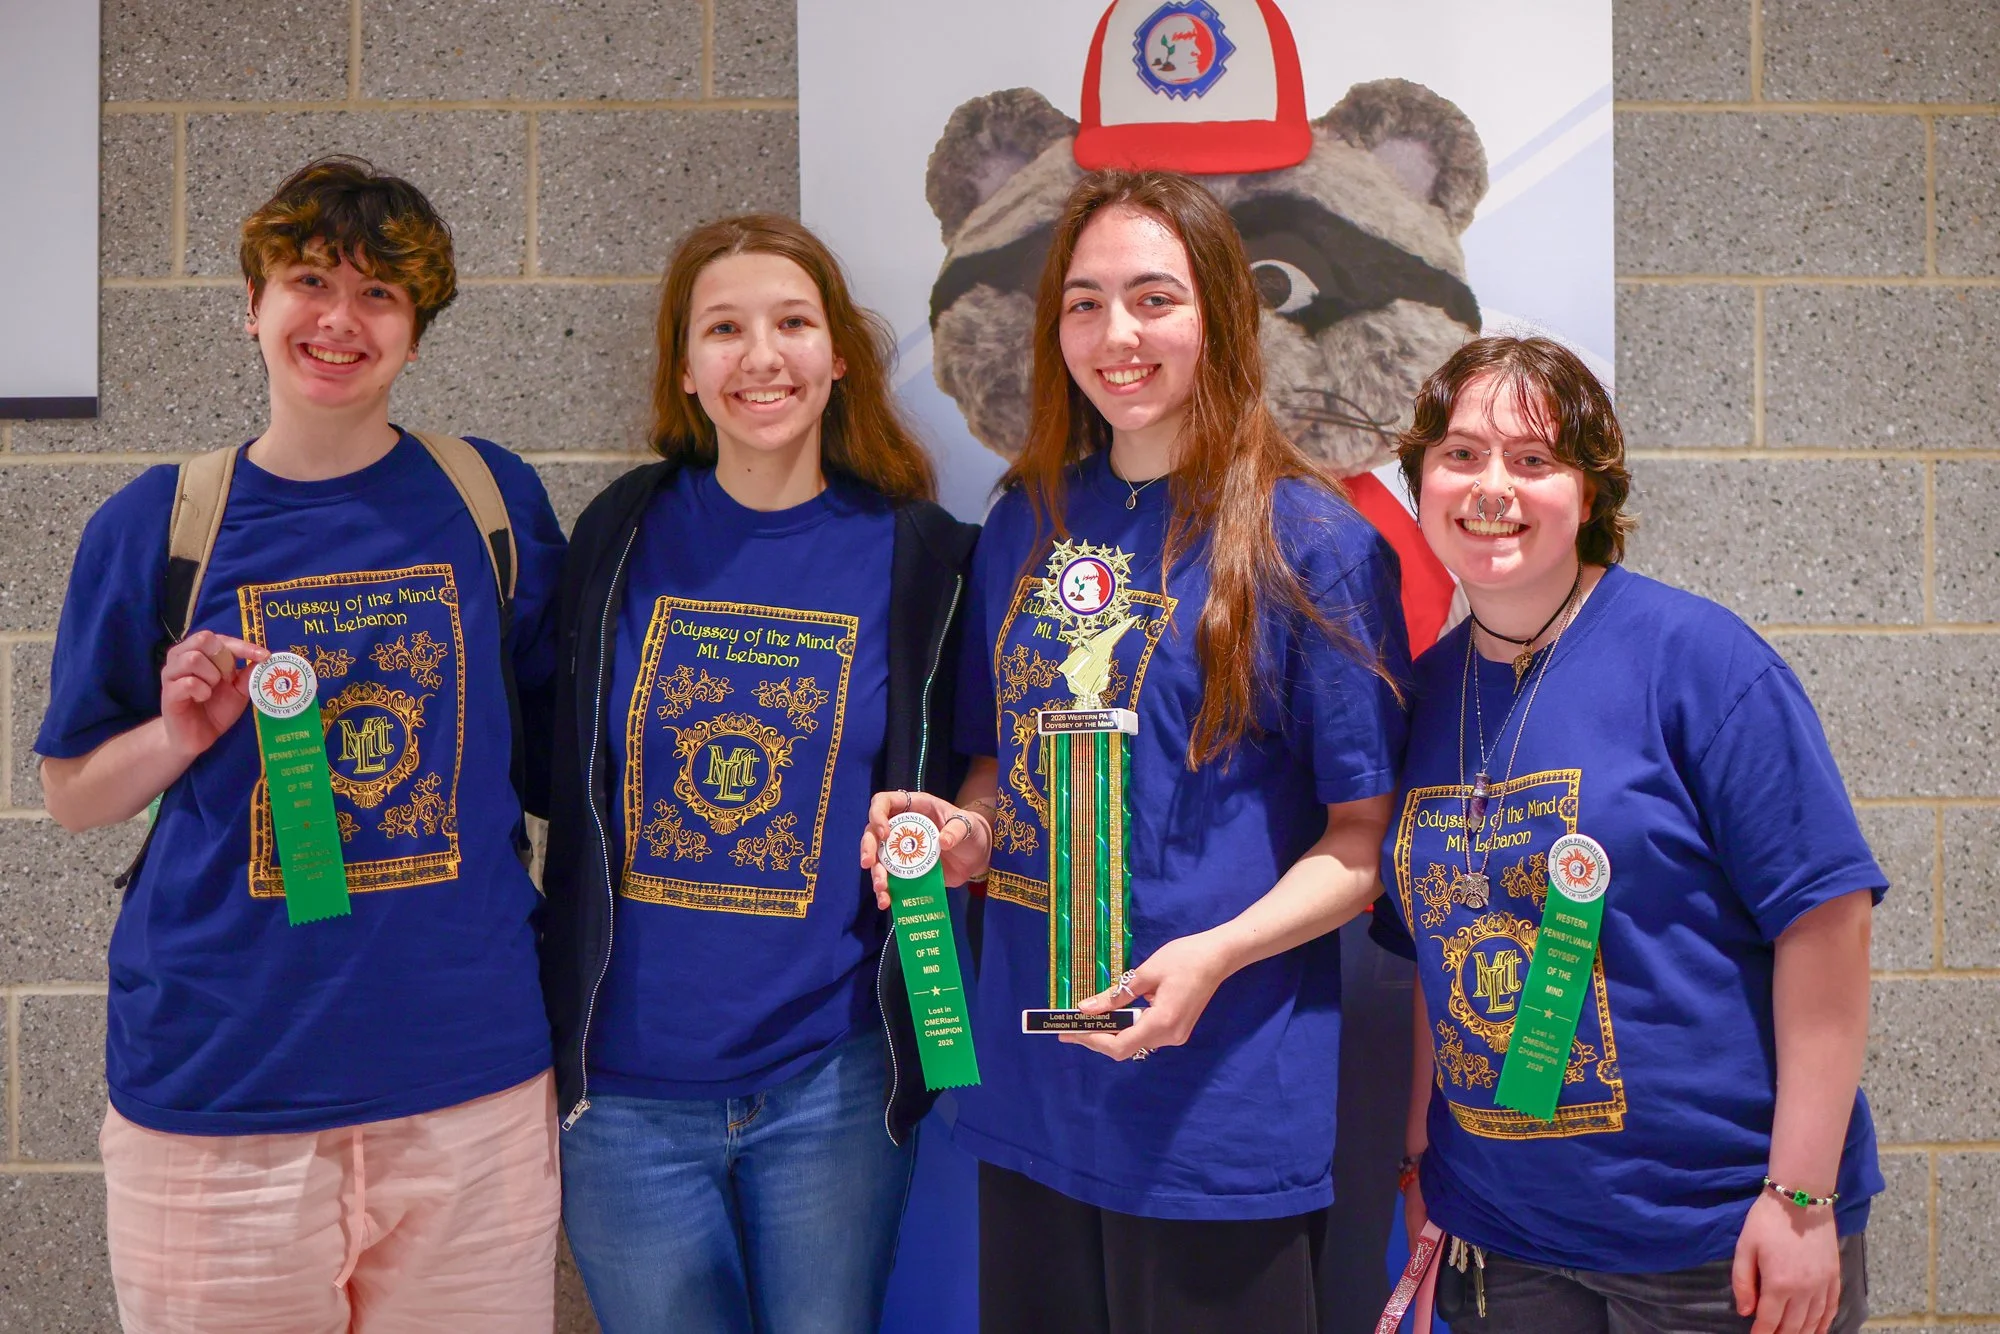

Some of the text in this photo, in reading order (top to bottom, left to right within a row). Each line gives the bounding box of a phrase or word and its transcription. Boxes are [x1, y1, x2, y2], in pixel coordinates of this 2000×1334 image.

[265, 587, 436, 620] Odyssey of the Mind
[304, 611, 407, 635] Mt. Lebanon
[1032, 621, 1052, 639] Mt.
[670, 619, 835, 650] Odyssey of the Mind
[696, 642, 800, 668] Mt. Lebanon
[253, 655, 312, 689] WESTERN PENNSYLVANIA
[257, 698, 282, 715] ODYSSEY
[292, 703, 303, 712] THE
[303, 688, 313, 704] MIND
[1099, 712, 1108, 720] PA
[1417, 795, 1556, 833] Odyssy of the Mind
[1474, 830, 1532, 852] Lebanon
[883, 857, 905, 874] ODYSSEY
[915, 865, 926, 873] THE
[926, 850, 937, 865] MIND
[1551, 838, 1606, 876] WESTERN PENNSYLVANIA
[902, 896, 934, 907] WESTERN
[897, 911, 946, 925] PENNSYLVANIA
[1555, 912, 1589, 929] WESTERN
[909, 929, 940, 942] ODYSSEY
[1542, 927, 1593, 951] PENNSYLVANIA
[916, 946, 940, 958] OF THE
[1547, 947, 1581, 964] ODYSSEY
[922, 964, 940, 974] MIND
[1546, 966, 1572, 982] OF THE
[1545, 984, 1564, 998] MIND
[924, 1016, 960, 1026] OMERland
[925, 1026, 963, 1037] CHAMPION
[938, 1038, 954, 1047] 2026
